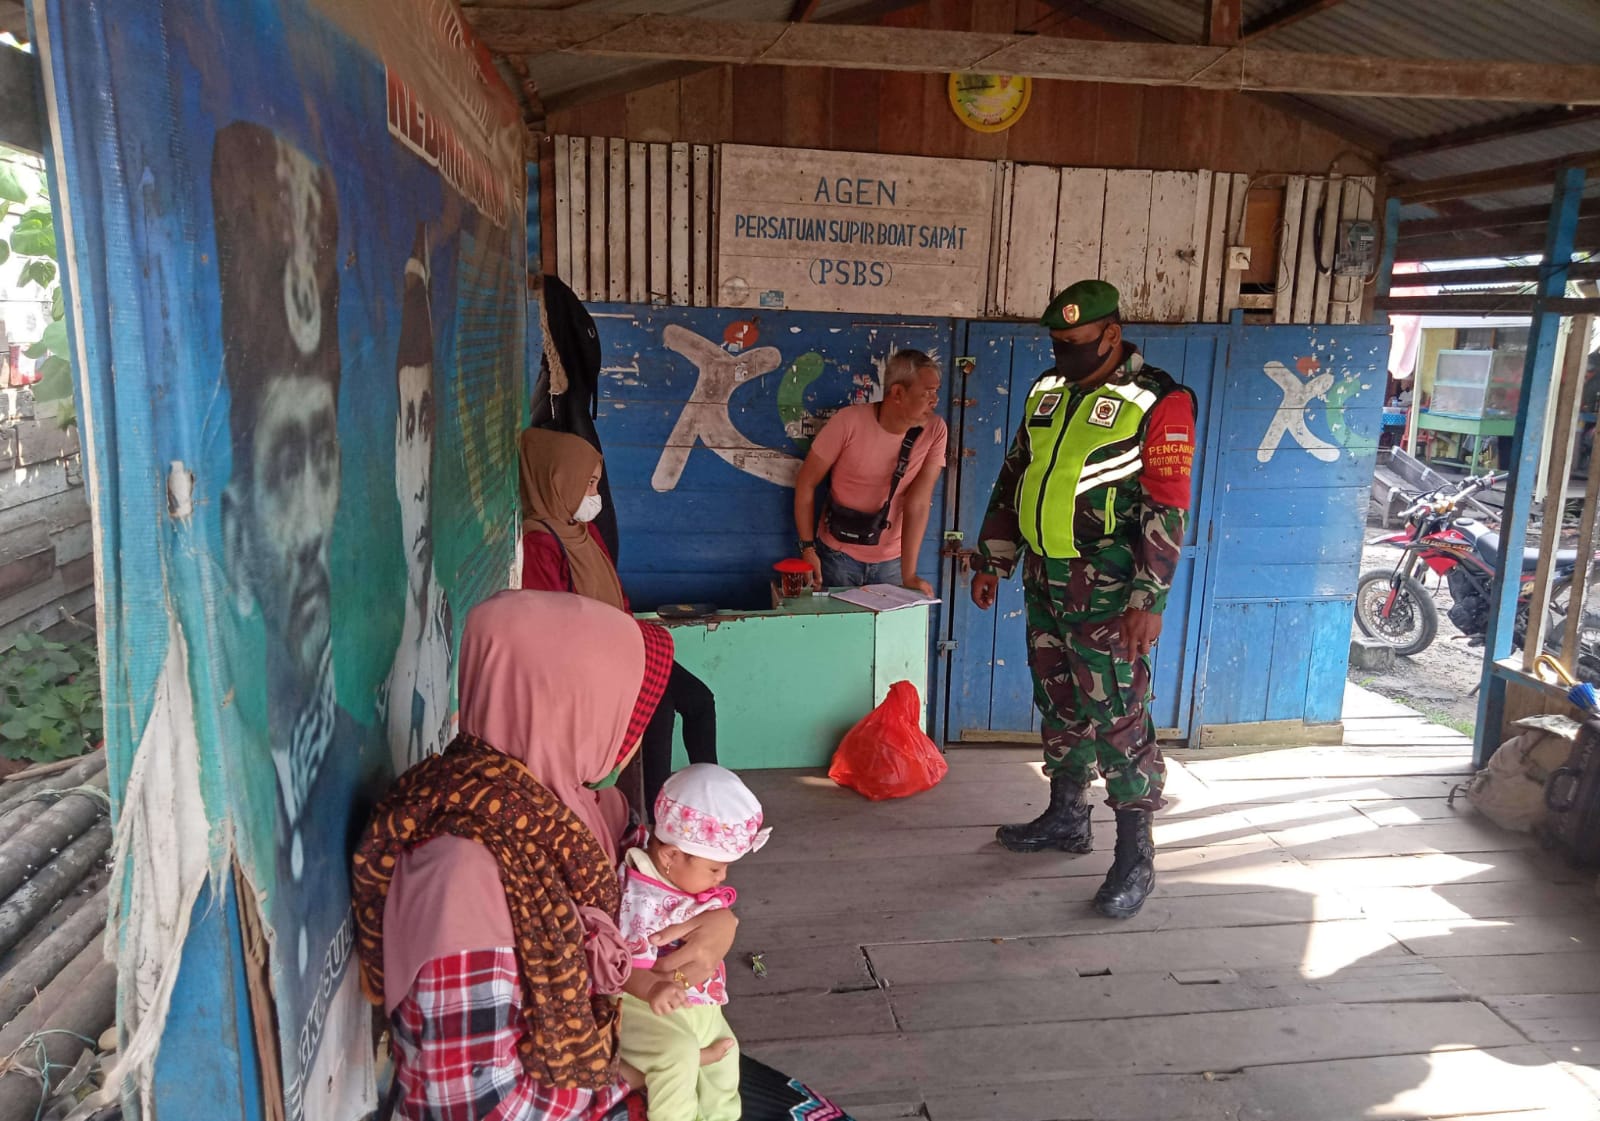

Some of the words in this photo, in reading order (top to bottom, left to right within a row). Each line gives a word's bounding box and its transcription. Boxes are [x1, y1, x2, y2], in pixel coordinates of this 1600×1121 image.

[814, 176, 897, 206] AGEN
[735, 214, 826, 242] PERSATUAN
[828, 220, 874, 245] SUPIR
[877, 223, 916, 247] BOAT
[808, 257, 893, 287] (PSBS)
